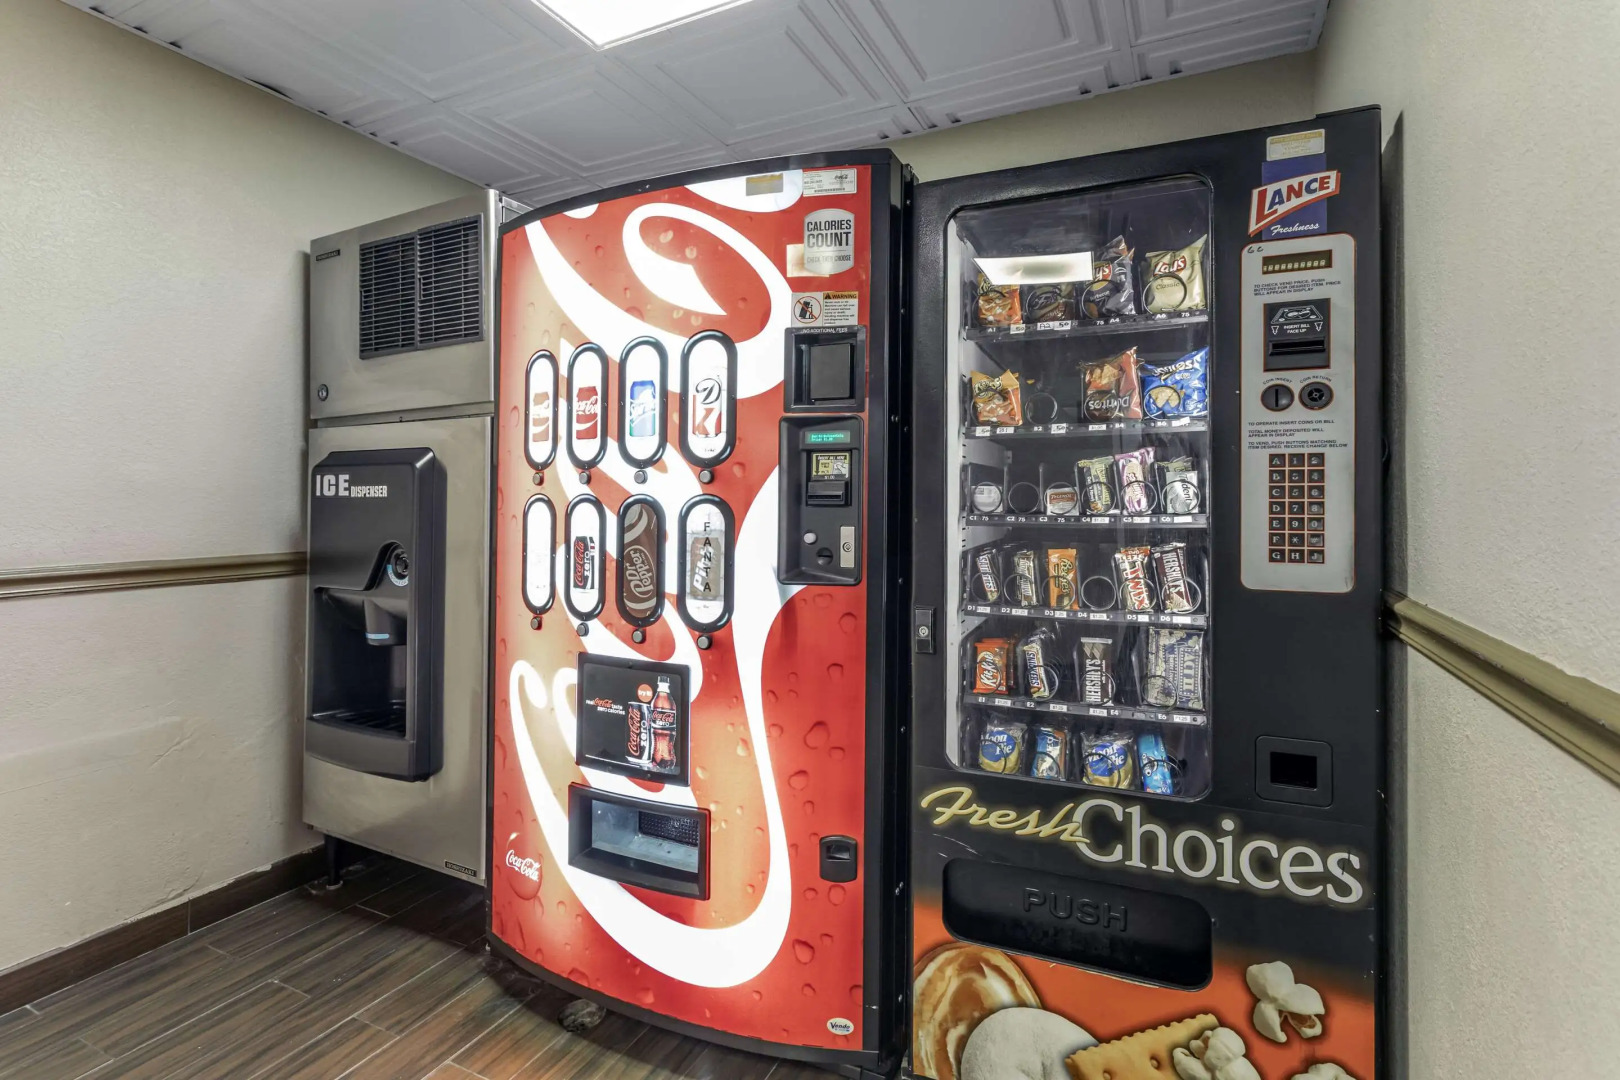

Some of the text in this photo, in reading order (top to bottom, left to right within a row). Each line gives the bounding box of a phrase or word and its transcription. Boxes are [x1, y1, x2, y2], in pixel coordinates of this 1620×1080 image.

[1256, 175, 1331, 226] LANCE
[806, 219, 851, 232] CALORIES
[1271, 223, 1320, 236] Freshness
[806, 232, 851, 249] COUNT
[834, 254, 851, 263] CHOOSE
[1156, 281, 1180, 291] Classic
[1300, 376, 1311, 384] COIN
[696, 378, 721, 405] D
[1272, 457, 1280, 465] A
[316, 474, 387, 498] ICE DISPENSER
[1178, 474, 1193, 502] Tdent
[1272, 520, 1318, 528] E 9 0
[704, 522, 712, 592] FANTA
[1291, 552, 1299, 560] H
[1126, 568, 1150, 610] TWIX
[1183, 652, 1196, 691] ACT II
[594, 698, 612, 708] Coca-Cola
[652, 710, 674, 723] Coca-Cola
[628, 706, 641, 756] Coca-Cola
[640, 720, 648, 747] zero
[981, 734, 1007, 745] Moon
[995, 744, 1012, 755] Pie
[1087, 744, 1117, 763] Moon
[1109, 754, 1125, 766] Pie
[920, 786, 1364, 904] Fresh Choices
[506, 850, 541, 882] Coca-Cola
[1023, 888, 1128, 933] PUSH
[830, 1022, 850, 1030] Vendo
